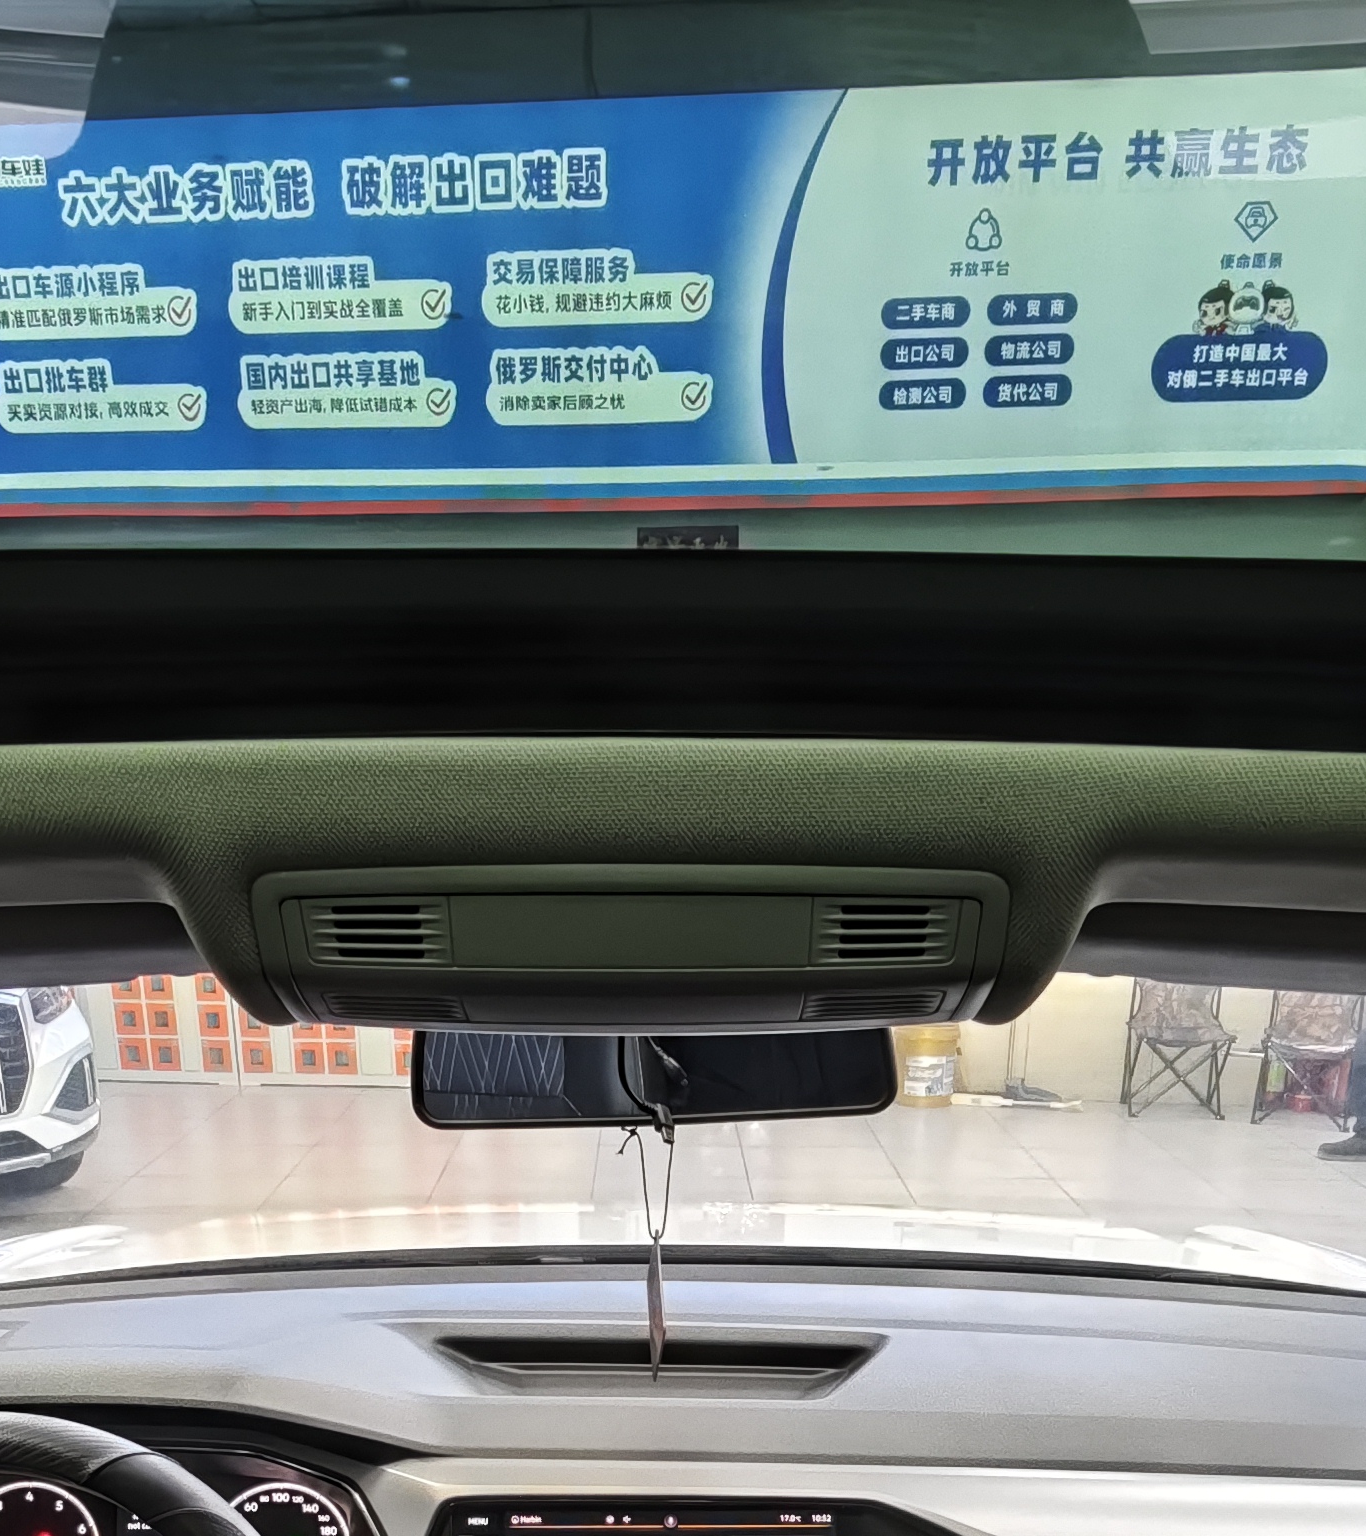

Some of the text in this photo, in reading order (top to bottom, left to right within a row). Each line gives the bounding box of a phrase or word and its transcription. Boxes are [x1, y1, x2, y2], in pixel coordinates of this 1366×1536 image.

[928, 124, 1310, 186] 开放平台 共赢生态
[62, 152, 604, 222] 六大业务赋能 破解出口难题
[492, 255, 630, 285] 交易保障服务
[949, 260, 1010, 277] 开放平台
[1220, 252, 1283, 270] 使命愿景
[237, 263, 371, 293] 出口培训课程
[242, 298, 404, 322] 新手入门到实战全覆盖
[896, 302, 955, 322] 二手车商
[1002, 299, 1066, 319] 外贸商
[895, 344, 955, 364] 出口公司
[1000, 340, 1062, 360] 物流公司
[1192, 343, 1289, 363] 打造中国最大
[2, 365, 109, 394] 出口批车群
[245, 358, 421, 390] 国内出口共享基地
[495, 354, 654, 385] 俄罗斯交付中心
[1166, 367, 1309, 389] 对俄二手车出口平台
[893, 385, 953, 406] 检测公司
[997, 382, 1059, 402] 货代公司
[499, 393, 626, 412] 消除卖家后顾之忧
[25, 1491, 34, 1502] 4
[55, 1501, 63, 1511] 5
[272, 1493, 290, 1502] 100
[244, 1502, 258, 1512] 60
[302, 1503, 319, 1513] 140
[318, 1514, 330, 1522] 160
[467, 1517, 489, 1526] MENU
[78, 1524, 86, 1534] 6
[320, 1526, 337, 1536] 180
